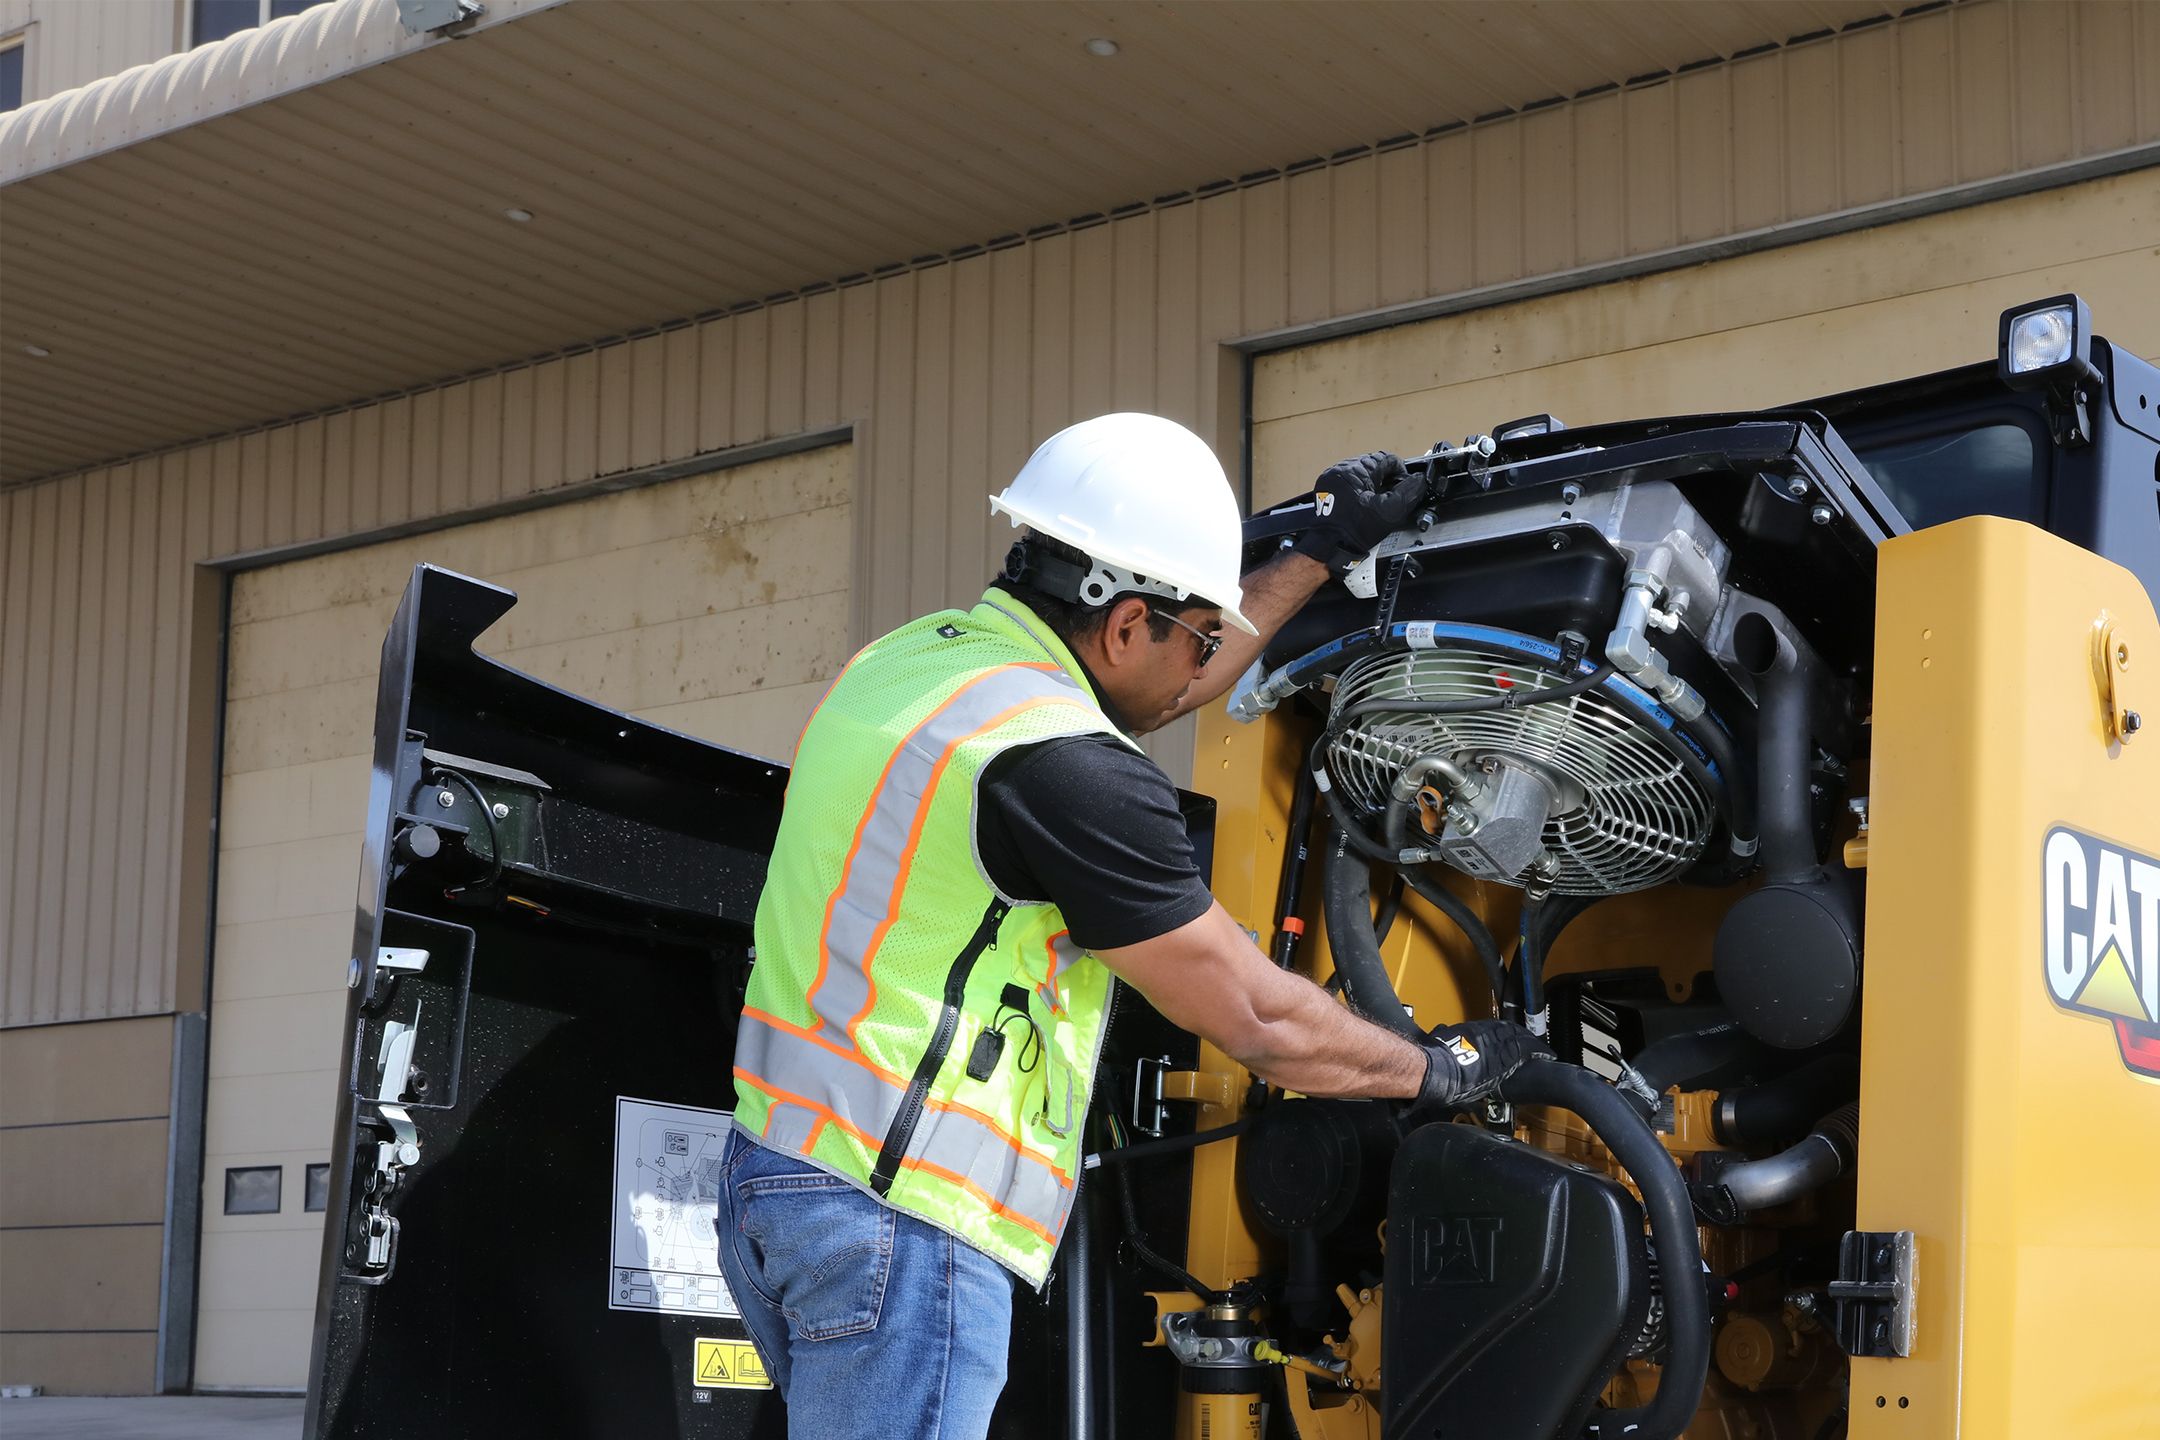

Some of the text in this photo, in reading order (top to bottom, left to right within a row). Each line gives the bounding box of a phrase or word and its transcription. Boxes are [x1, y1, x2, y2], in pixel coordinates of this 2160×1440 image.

[1316, 493, 1335, 517] CA
[2045, 831, 2160, 1024] CAT
[1413, 1216, 1503, 1284] CAT
[695, 1392, 709, 1400] 12V
